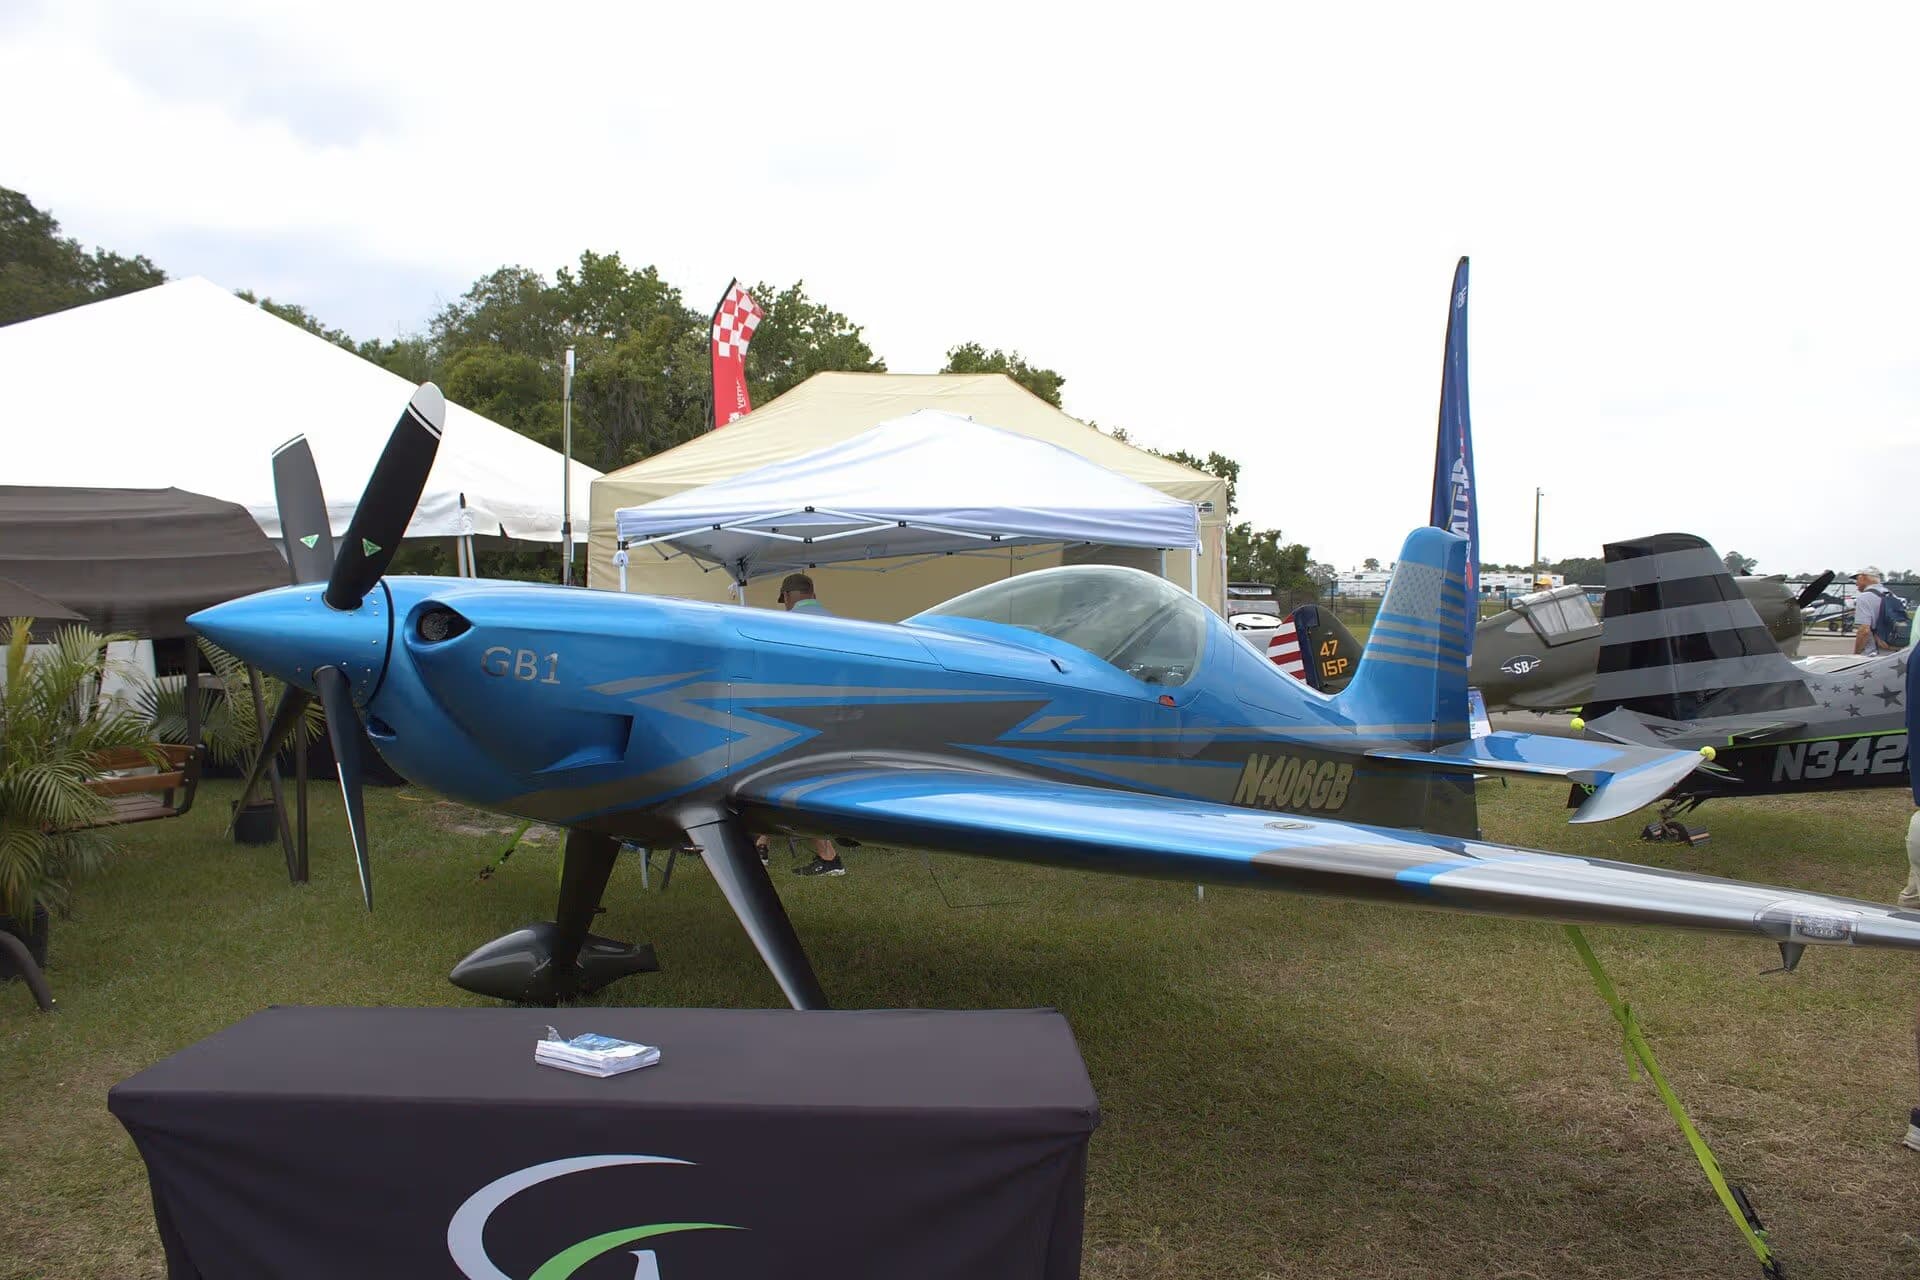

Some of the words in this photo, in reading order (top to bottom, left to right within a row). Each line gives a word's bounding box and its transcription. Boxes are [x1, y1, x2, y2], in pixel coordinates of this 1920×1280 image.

[481, 646, 560, 684] GB1
[1320, 640, 1338, 656] 47
[1513, 661, 1530, 674] SB
[1772, 733, 1910, 782] N342
[1233, 753, 1353, 809] N406GB
